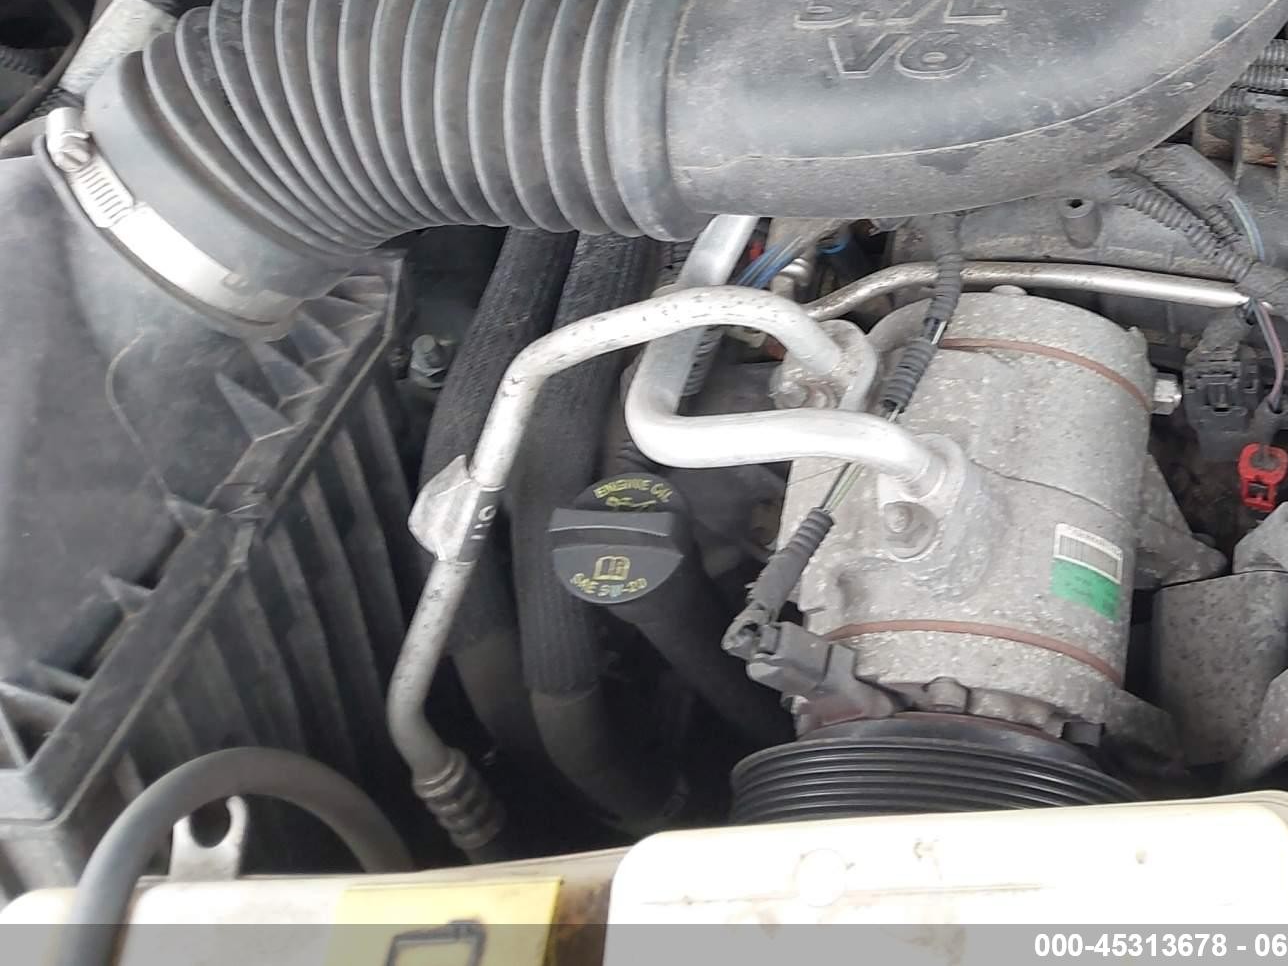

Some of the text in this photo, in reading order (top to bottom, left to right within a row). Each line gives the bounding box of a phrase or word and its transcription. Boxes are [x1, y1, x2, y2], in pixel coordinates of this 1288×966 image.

[826, 28, 977, 80] V6
[592, 478, 674, 503] ENGINE OIL
[569, 572, 648, 598] SAE 5W-20
